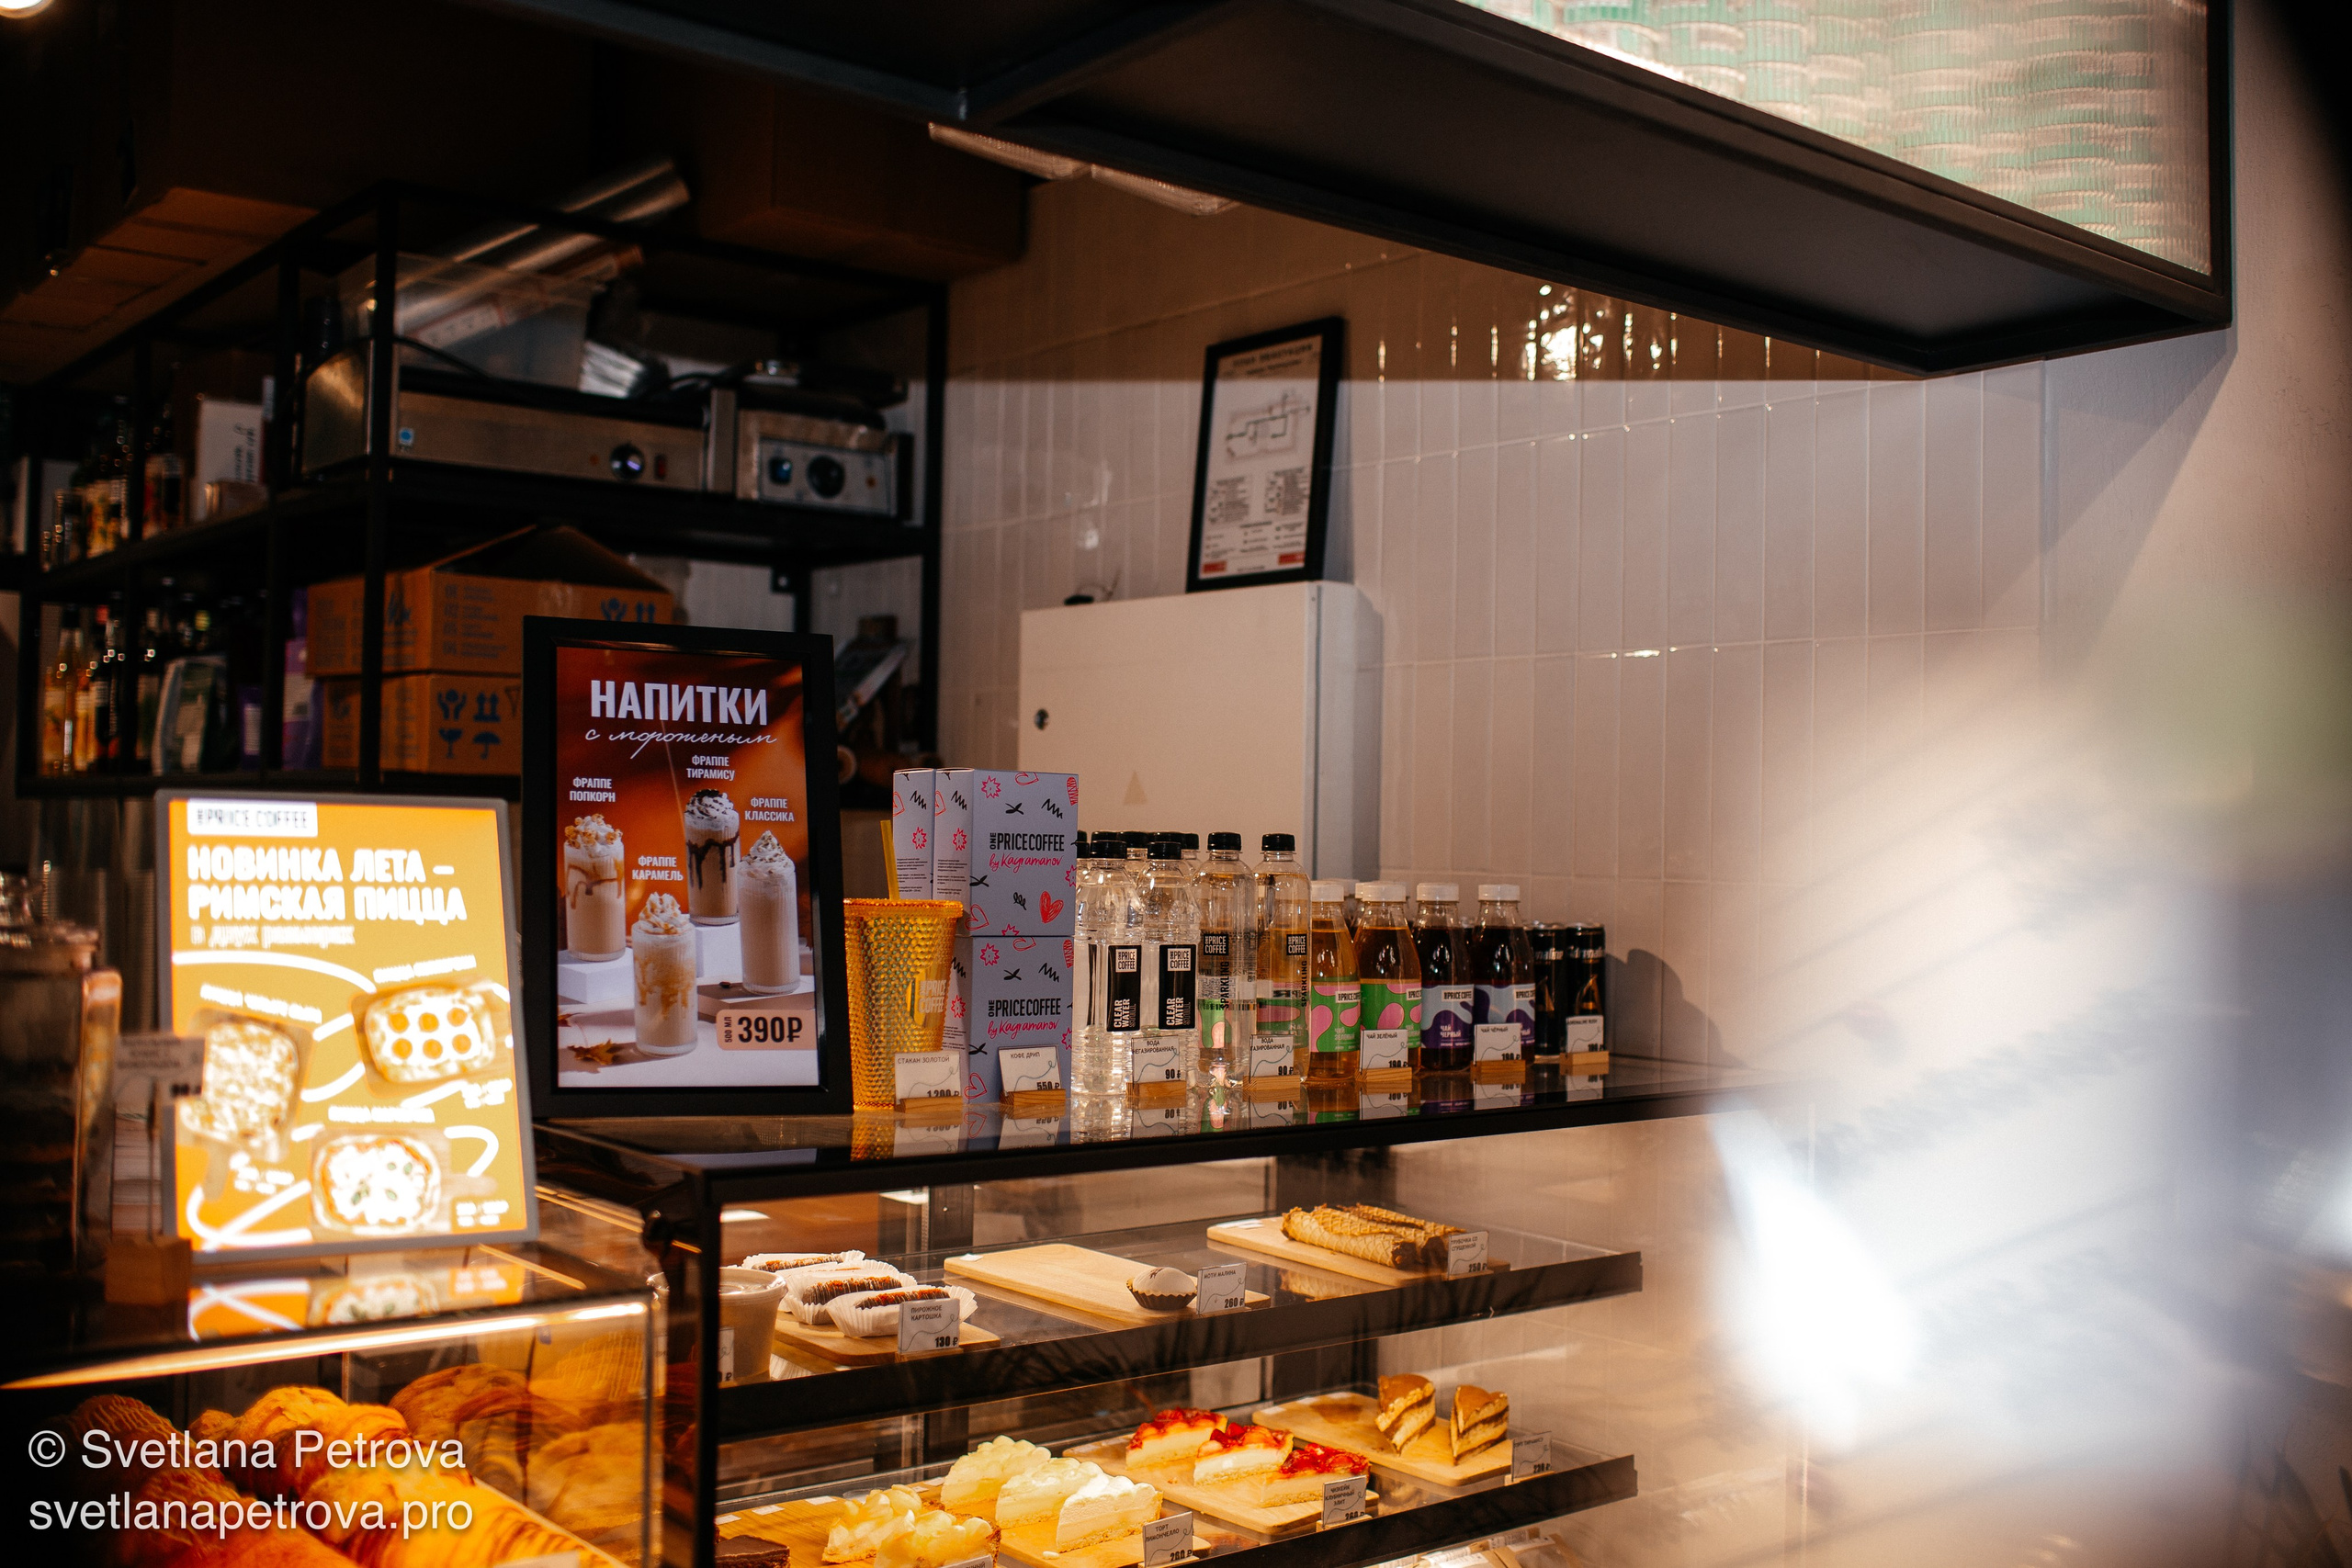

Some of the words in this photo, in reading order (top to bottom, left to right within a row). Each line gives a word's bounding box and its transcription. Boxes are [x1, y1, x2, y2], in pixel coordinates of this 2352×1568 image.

[591, 680, 767, 726] НАПИТКИ
[585, 728, 600, 740] с
[608, 728, 778, 760] мороженым
[691, 754, 729, 767] ФРАППЕ
[686, 767, 735, 781] ТИРАМИСУ
[572, 776, 613, 789] ФРАППЕ
[569, 789, 616, 802] ПОПКОРН
[750, 796, 788, 809] ФРАППЕ
[744, 810, 795, 822] КЛАССИКА
[187, 843, 344, 882] НОВИНКА
[349, 848, 426, 882] ЛЕТА
[638, 855, 677, 867] ФРАППЕ
[989, 852, 1000, 872] by
[1001, 852, 1065, 874] Kagramanov
[632, 869, 684, 881] КАРАМЕЛЬ
[187, 884, 345, 920] РИМСКАЯ
[354, 886, 467, 925] ПИЦЦА
[1208, 936, 1227, 944] PRICE
[1292, 936, 1306, 944] PRICE
[1174, 951, 1189, 959] PRICE
[1204, 945, 1227, 953] COFFEE
[1288, 945, 1306, 953] COFFEE
[1122, 952, 1135, 960] PRICE
[1118, 961, 1135, 969] COFFEE
[1170, 960, 1189, 968] COFFEE
[1220, 961, 1229, 1009] SPARKLING
[1114, 999, 1122, 1028] CLEAR
[1122, 998, 1130, 1028] WATER
[1166, 998, 1175, 1026] CLEAR
[1175, 997, 1184, 1025] WATER
[723, 1016, 732, 1027] МЛ
[988, 1021, 998, 1040] by
[999, 1018, 1061, 1040] Kagramanov
[724, 1030, 732, 1043] 500
[1132, 1045, 1174, 1055] НЕГАЗИРОВАННАЯ
[1250, 1043, 1285, 1052] ГАЗИРОВАННАЯ
[922, 1055, 950, 1064] ЗОЛОТОЙ
[1165, 1068, 1175, 1079] 90
[1225, 1297, 1238, 1308] 260
[911, 1305, 942, 1314] ПИРОЖНОЕ
[911, 1313, 942, 1321] КАРТОШКА
[935, 1336, 950, 1348] 130
